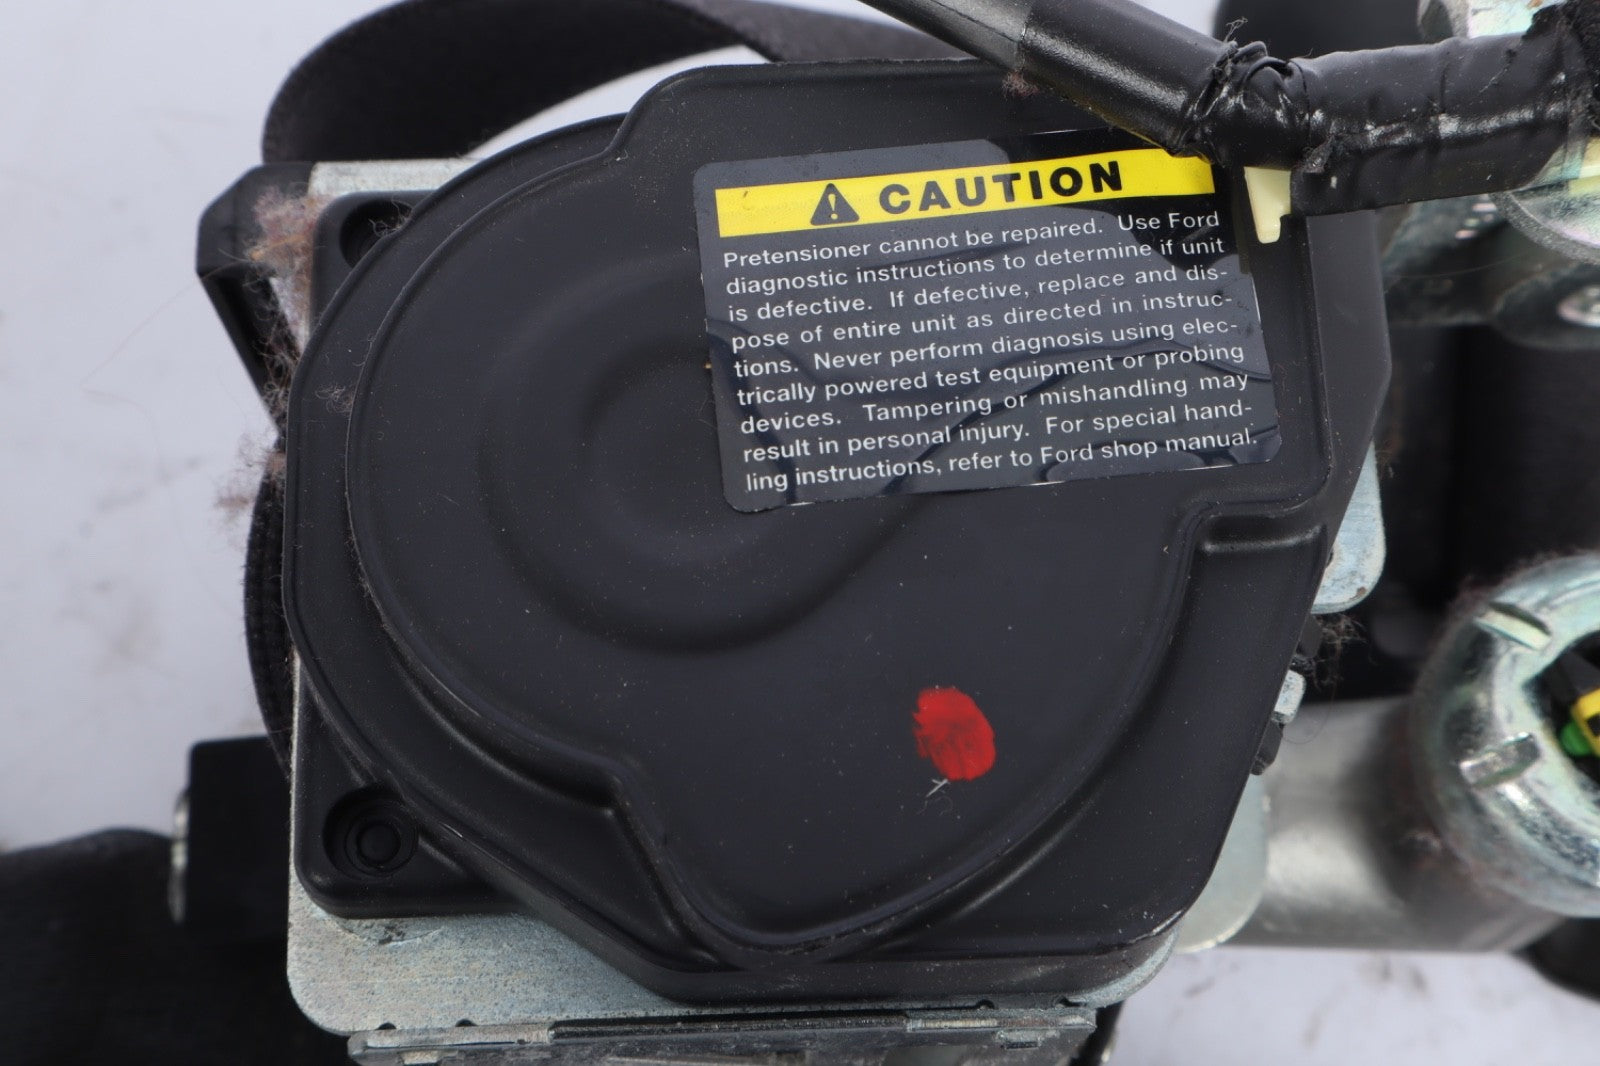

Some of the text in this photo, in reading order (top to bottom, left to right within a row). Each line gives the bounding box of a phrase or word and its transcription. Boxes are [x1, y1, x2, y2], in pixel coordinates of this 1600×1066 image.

[878, 161, 1123, 215] CAUTION
[724, 210, 1220, 268] Pretensioner cannot be repaired. Use Ford
[726, 237, 1225, 296] diagnostic instructions to determine if unit
[728, 264, 1227, 322] is defective. If defective, replace and dis-
[732, 292, 1232, 354] pose of entire unit as directed in instruc-
[733, 318, 1237, 378] tions. Never perform diagnosis using elec-
[736, 344, 1244, 406] trically powered test equipment or probing
[741, 374, 1248, 434] devices. Tampering or mishandling may
[744, 399, 1252, 463] result in personal injury. For special hand-
[746, 427, 1257, 492] ling instructions, refer to Ford shop manual.
